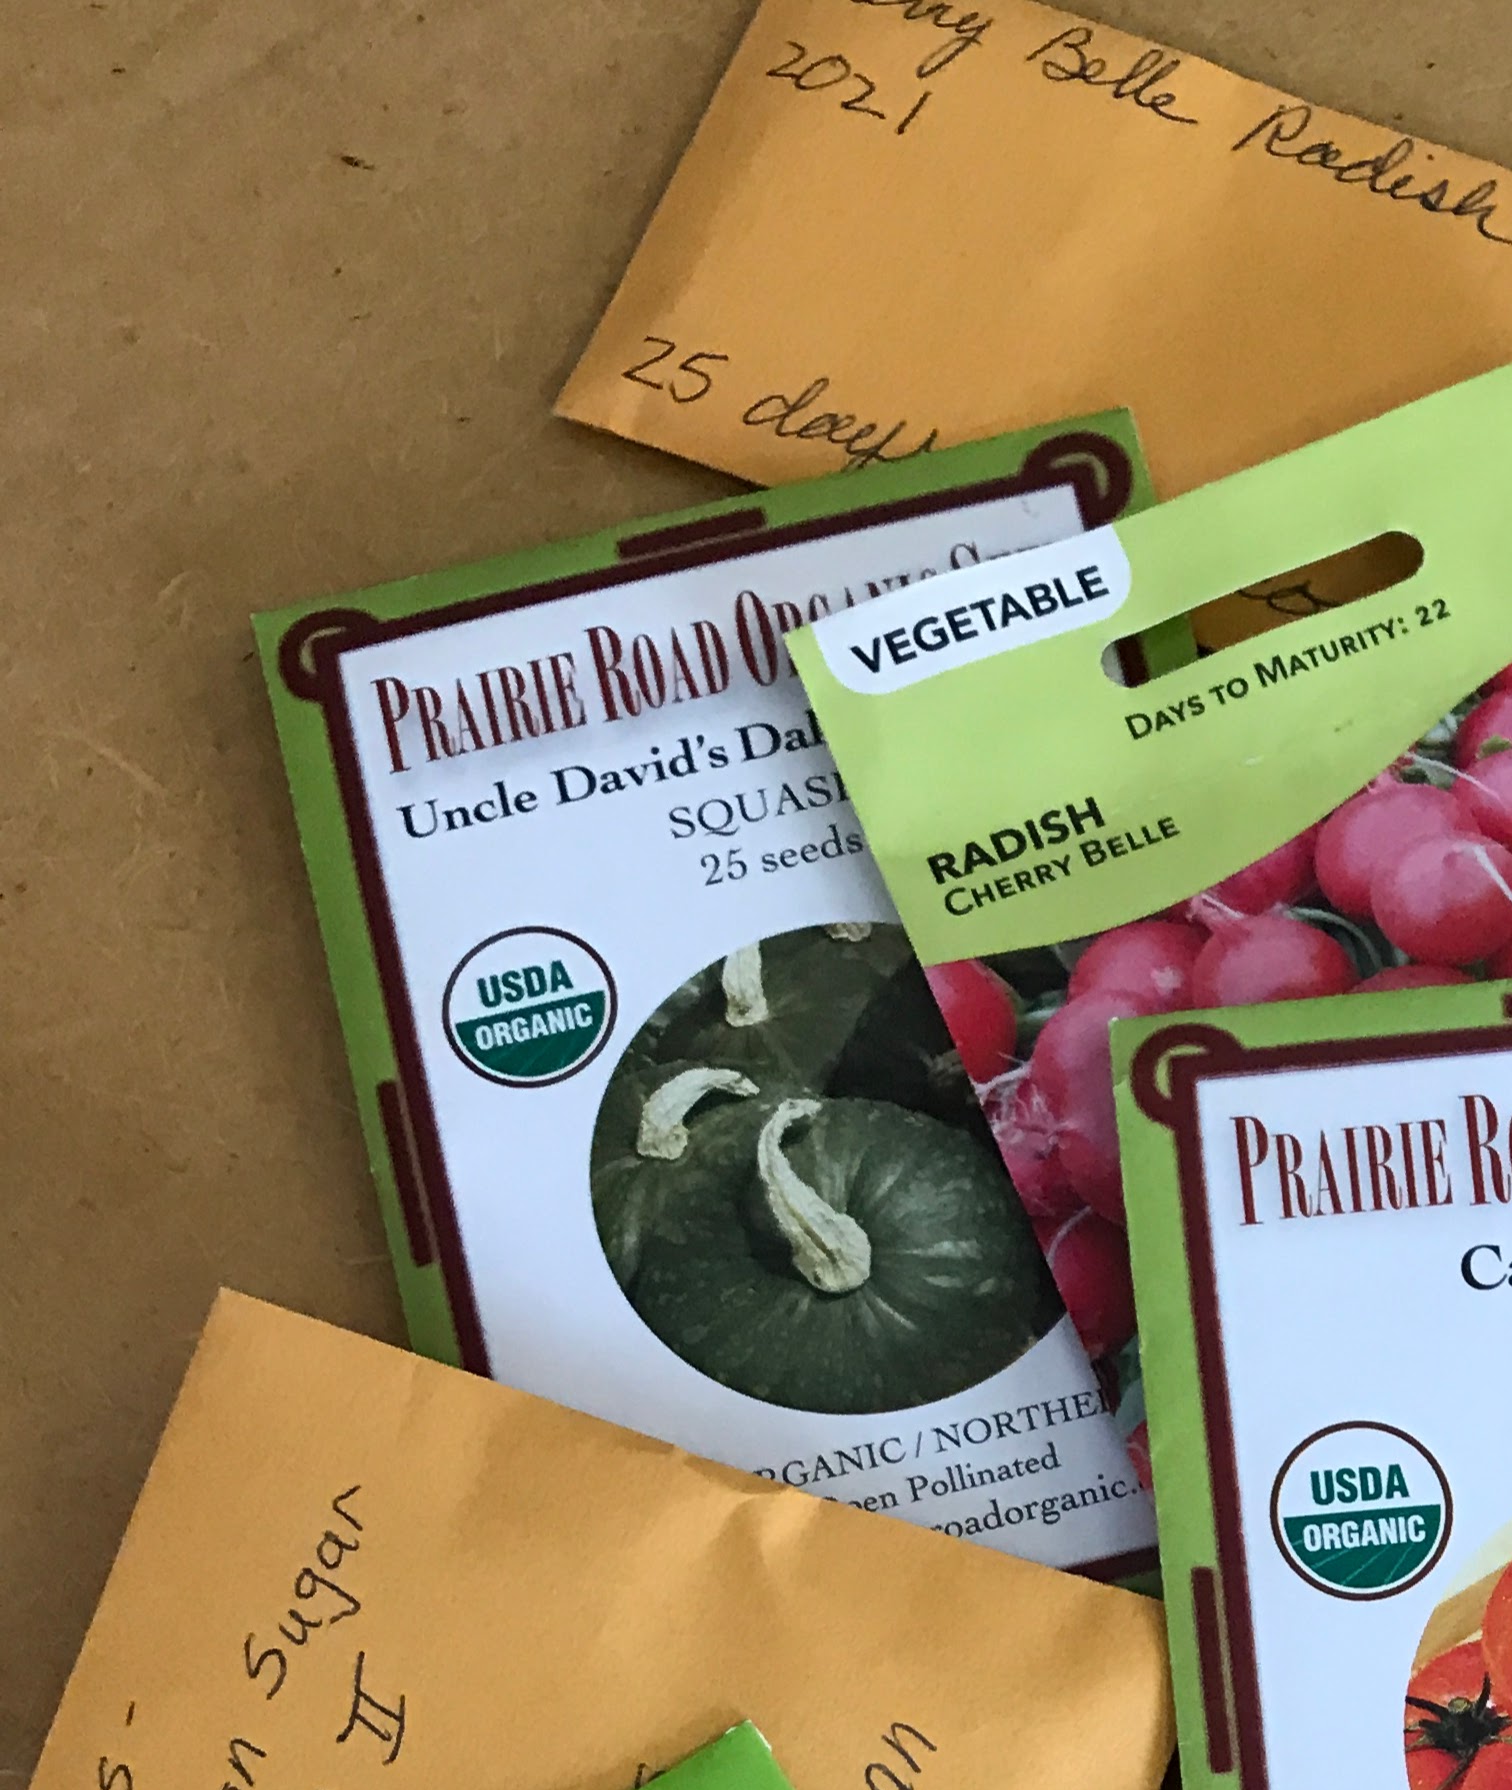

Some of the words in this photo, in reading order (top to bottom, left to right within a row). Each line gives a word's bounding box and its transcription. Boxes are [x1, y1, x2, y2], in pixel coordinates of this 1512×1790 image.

[766, 40, 932, 136] 2021
[1025, 26, 1199, 126] Belle
[621, 335, 729, 404] 25
[850, 564, 1110, 674] VEGETABLE
[1415, 598, 1451, 628] 22
[371, 651, 588, 775] PRAIRIE
[584, 620, 730, 724] ROAD
[397, 784, 538, 841] Uncle
[553, 733, 729, 807] David's
[700, 848, 748, 886] 25
[761, 822, 864, 873] seeds
[926, 798, 1107, 885] RADISH
[944, 858, 1071, 918] CHERRY
[1084, 816, 1180, 868] BELLE
[474, 1004, 593, 1053] ORGANIC
[476, 960, 574, 1010] USDA
[1231, 1115, 1453, 1227] PRAIRIE
[906, 1442, 1062, 1503] Pollinated
[1311, 1463, 1411, 1505] USDA
[1302, 1514, 1427, 1552] ORGANIC
[244, 1485, 363, 1700] Sugar
[336, 1651, 406, 1765] II
